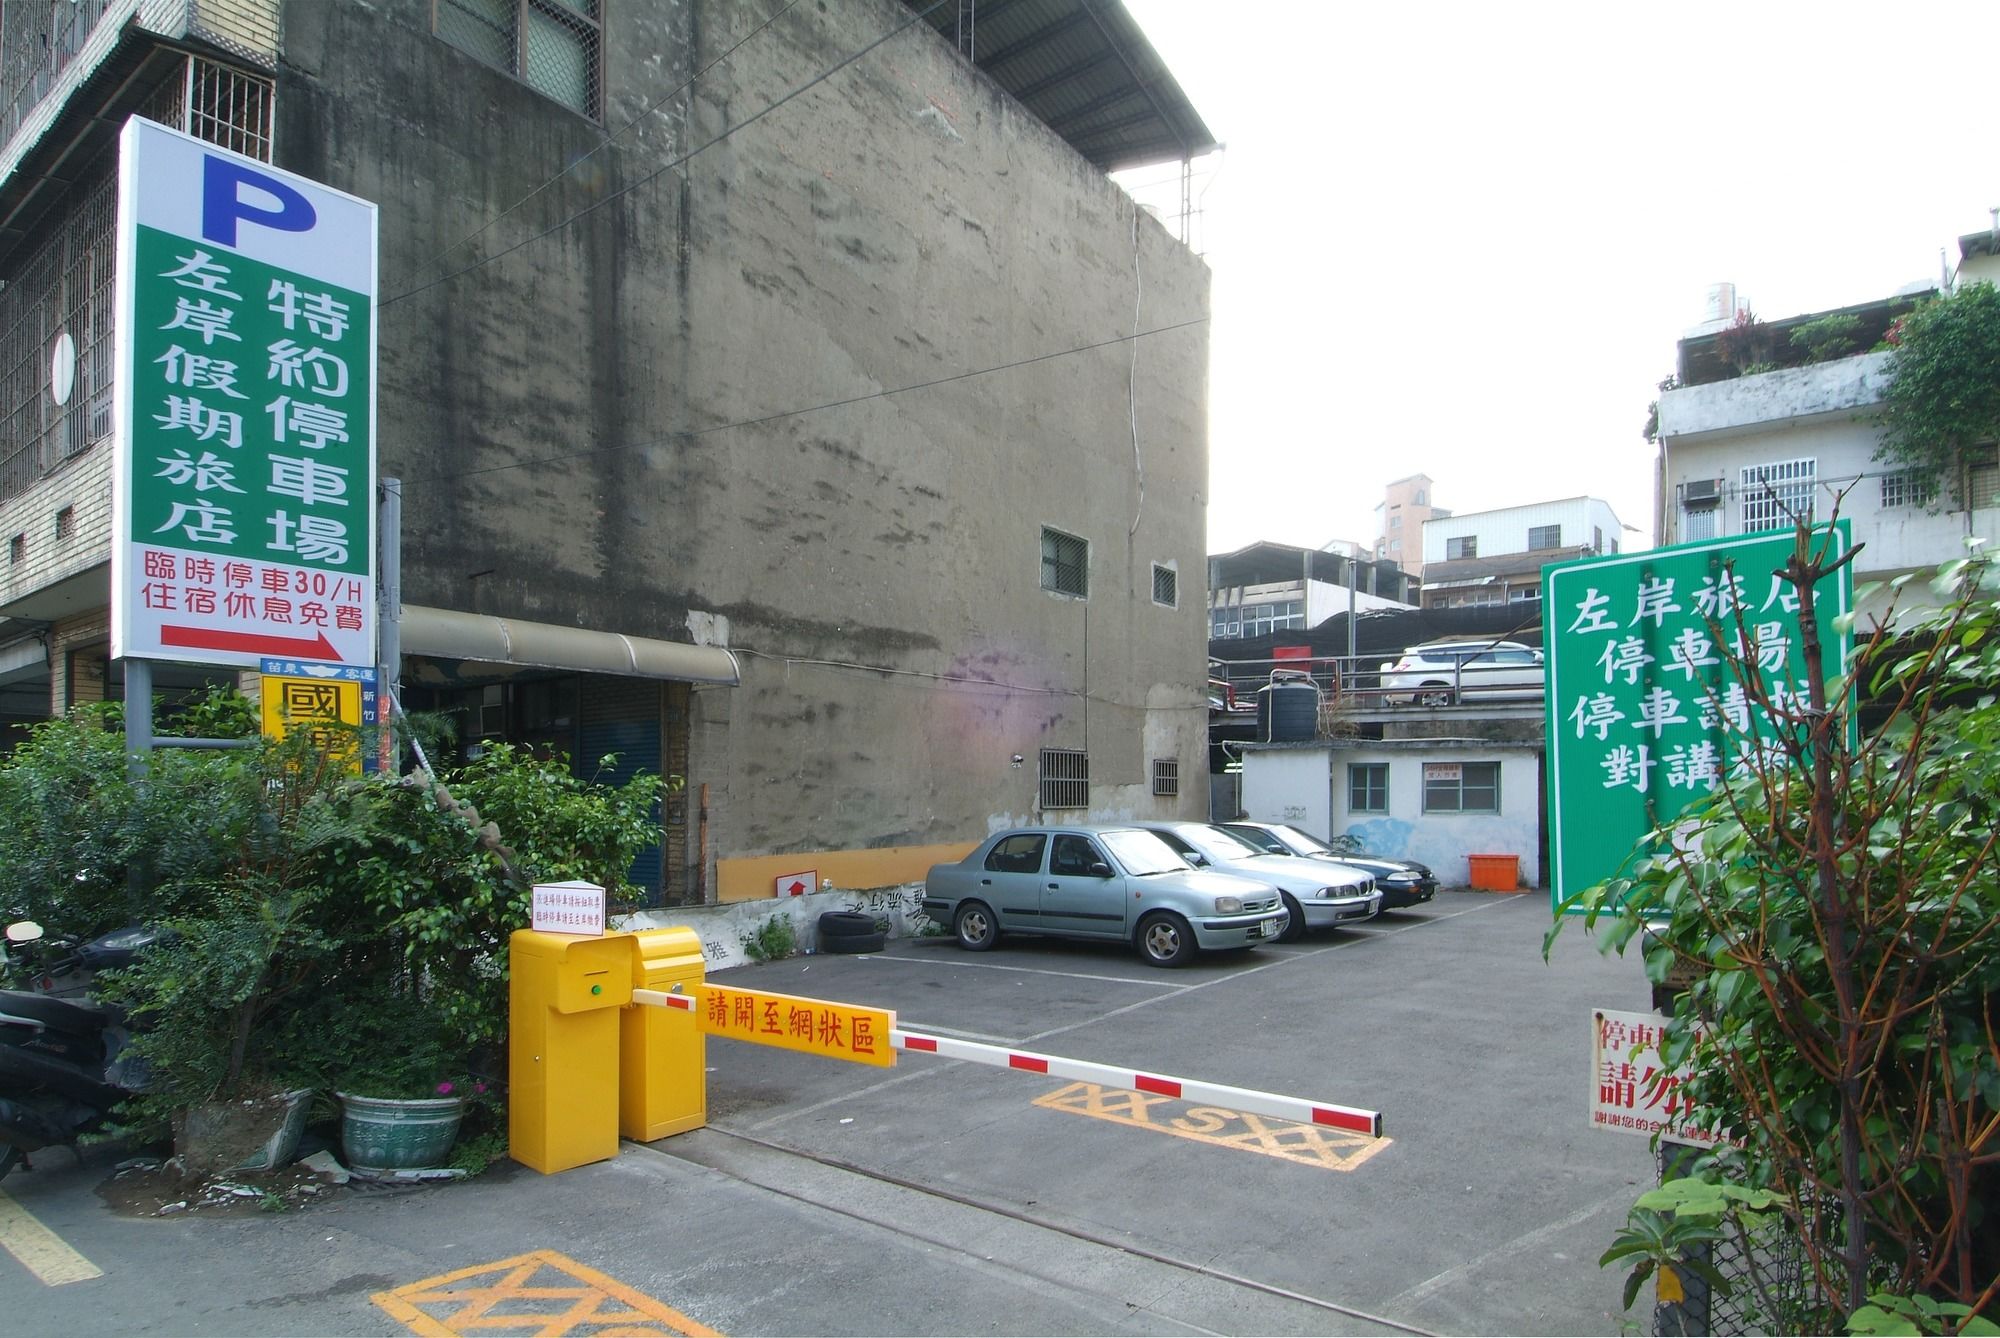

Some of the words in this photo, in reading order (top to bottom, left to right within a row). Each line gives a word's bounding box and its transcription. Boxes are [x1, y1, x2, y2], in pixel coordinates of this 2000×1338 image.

[202, 153, 317, 248] P
[152, 249, 250, 544] 左岸假期旅店
[265, 278, 350, 565] 特約停車場
[142, 582, 363, 632] 住宿休息免費
[144, 550, 362, 602] 臨時停車30/H
[1596, 620, 1793, 685] 停車場
[707, 990, 876, 1056] 請開至網狀區
